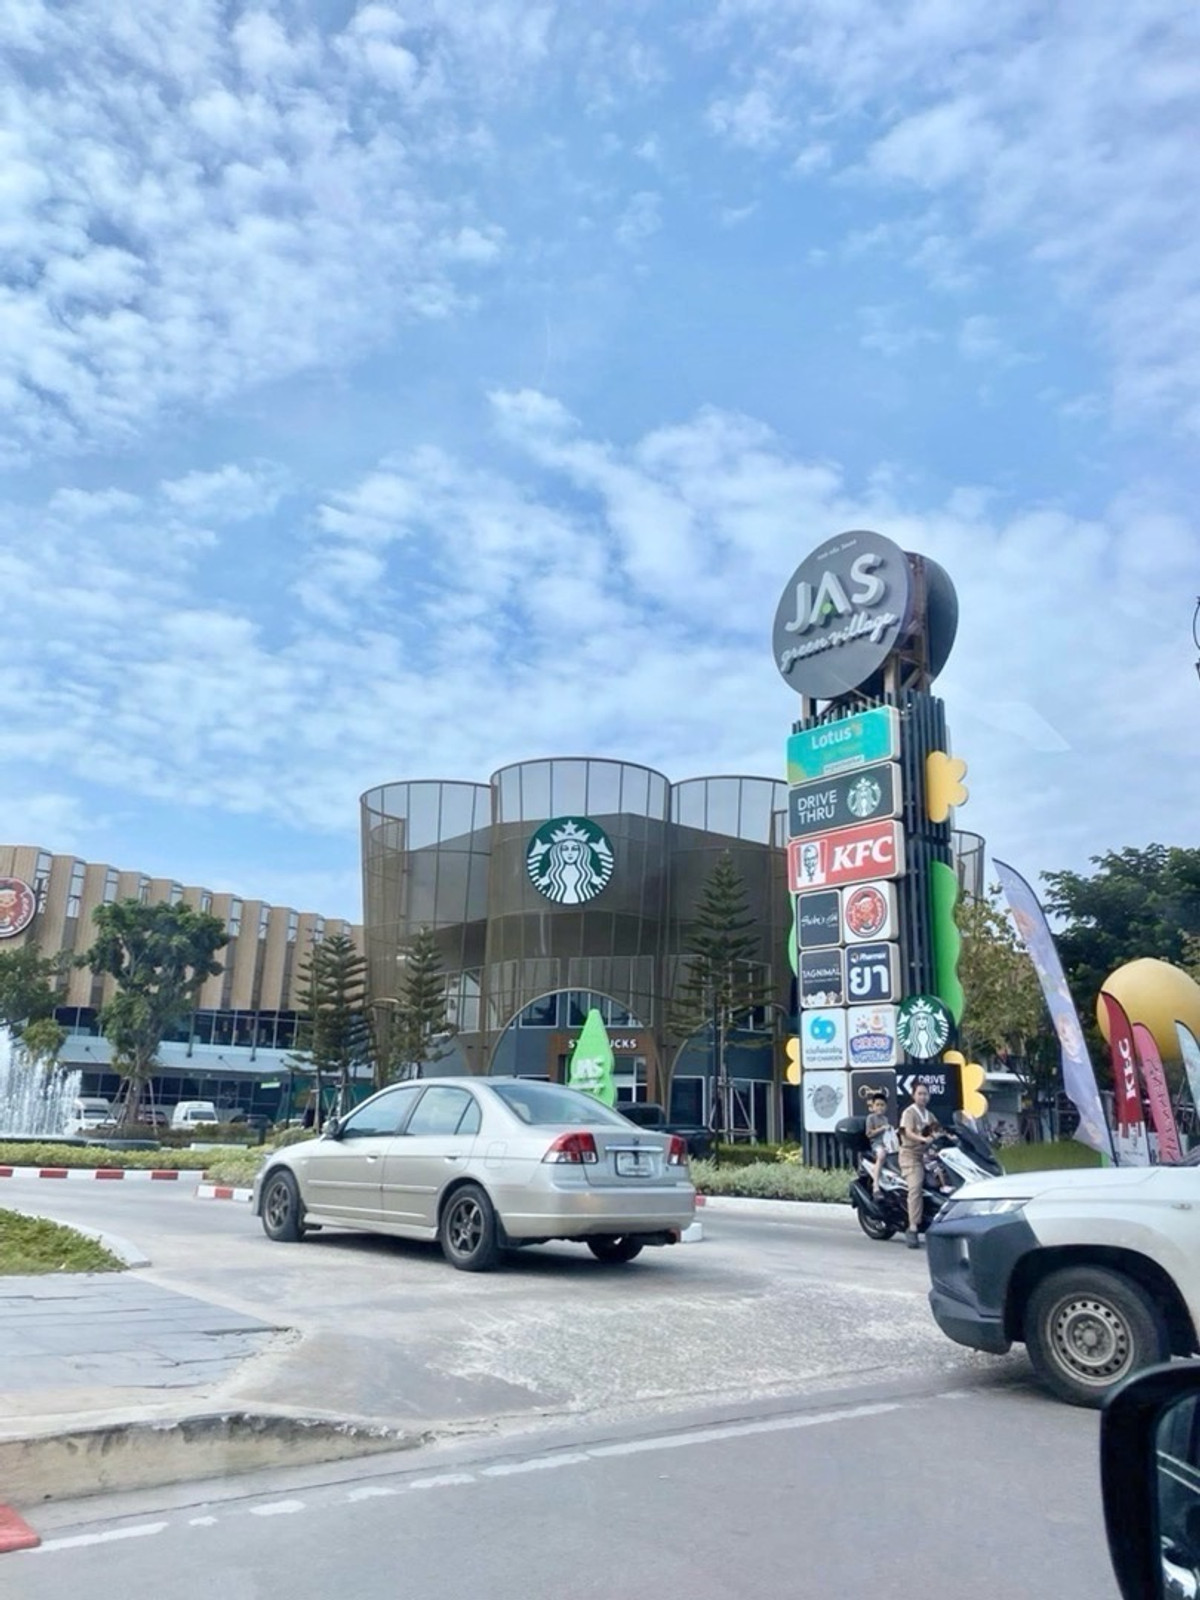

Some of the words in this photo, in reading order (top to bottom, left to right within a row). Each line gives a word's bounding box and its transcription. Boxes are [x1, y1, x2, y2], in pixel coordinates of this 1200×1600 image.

[785, 553, 886, 633] JAS
[780, 636, 829, 673] green
[829, 611, 898, 643] village
[798, 789, 837, 812] DRIVE
[799, 804, 835, 825] THRU
[831, 835, 893, 873] KFC
[850, 964, 889, 996] ยา
[918, 1074, 946, 1085] DRIVE
[1118, 1038, 1136, 1100] KFC
